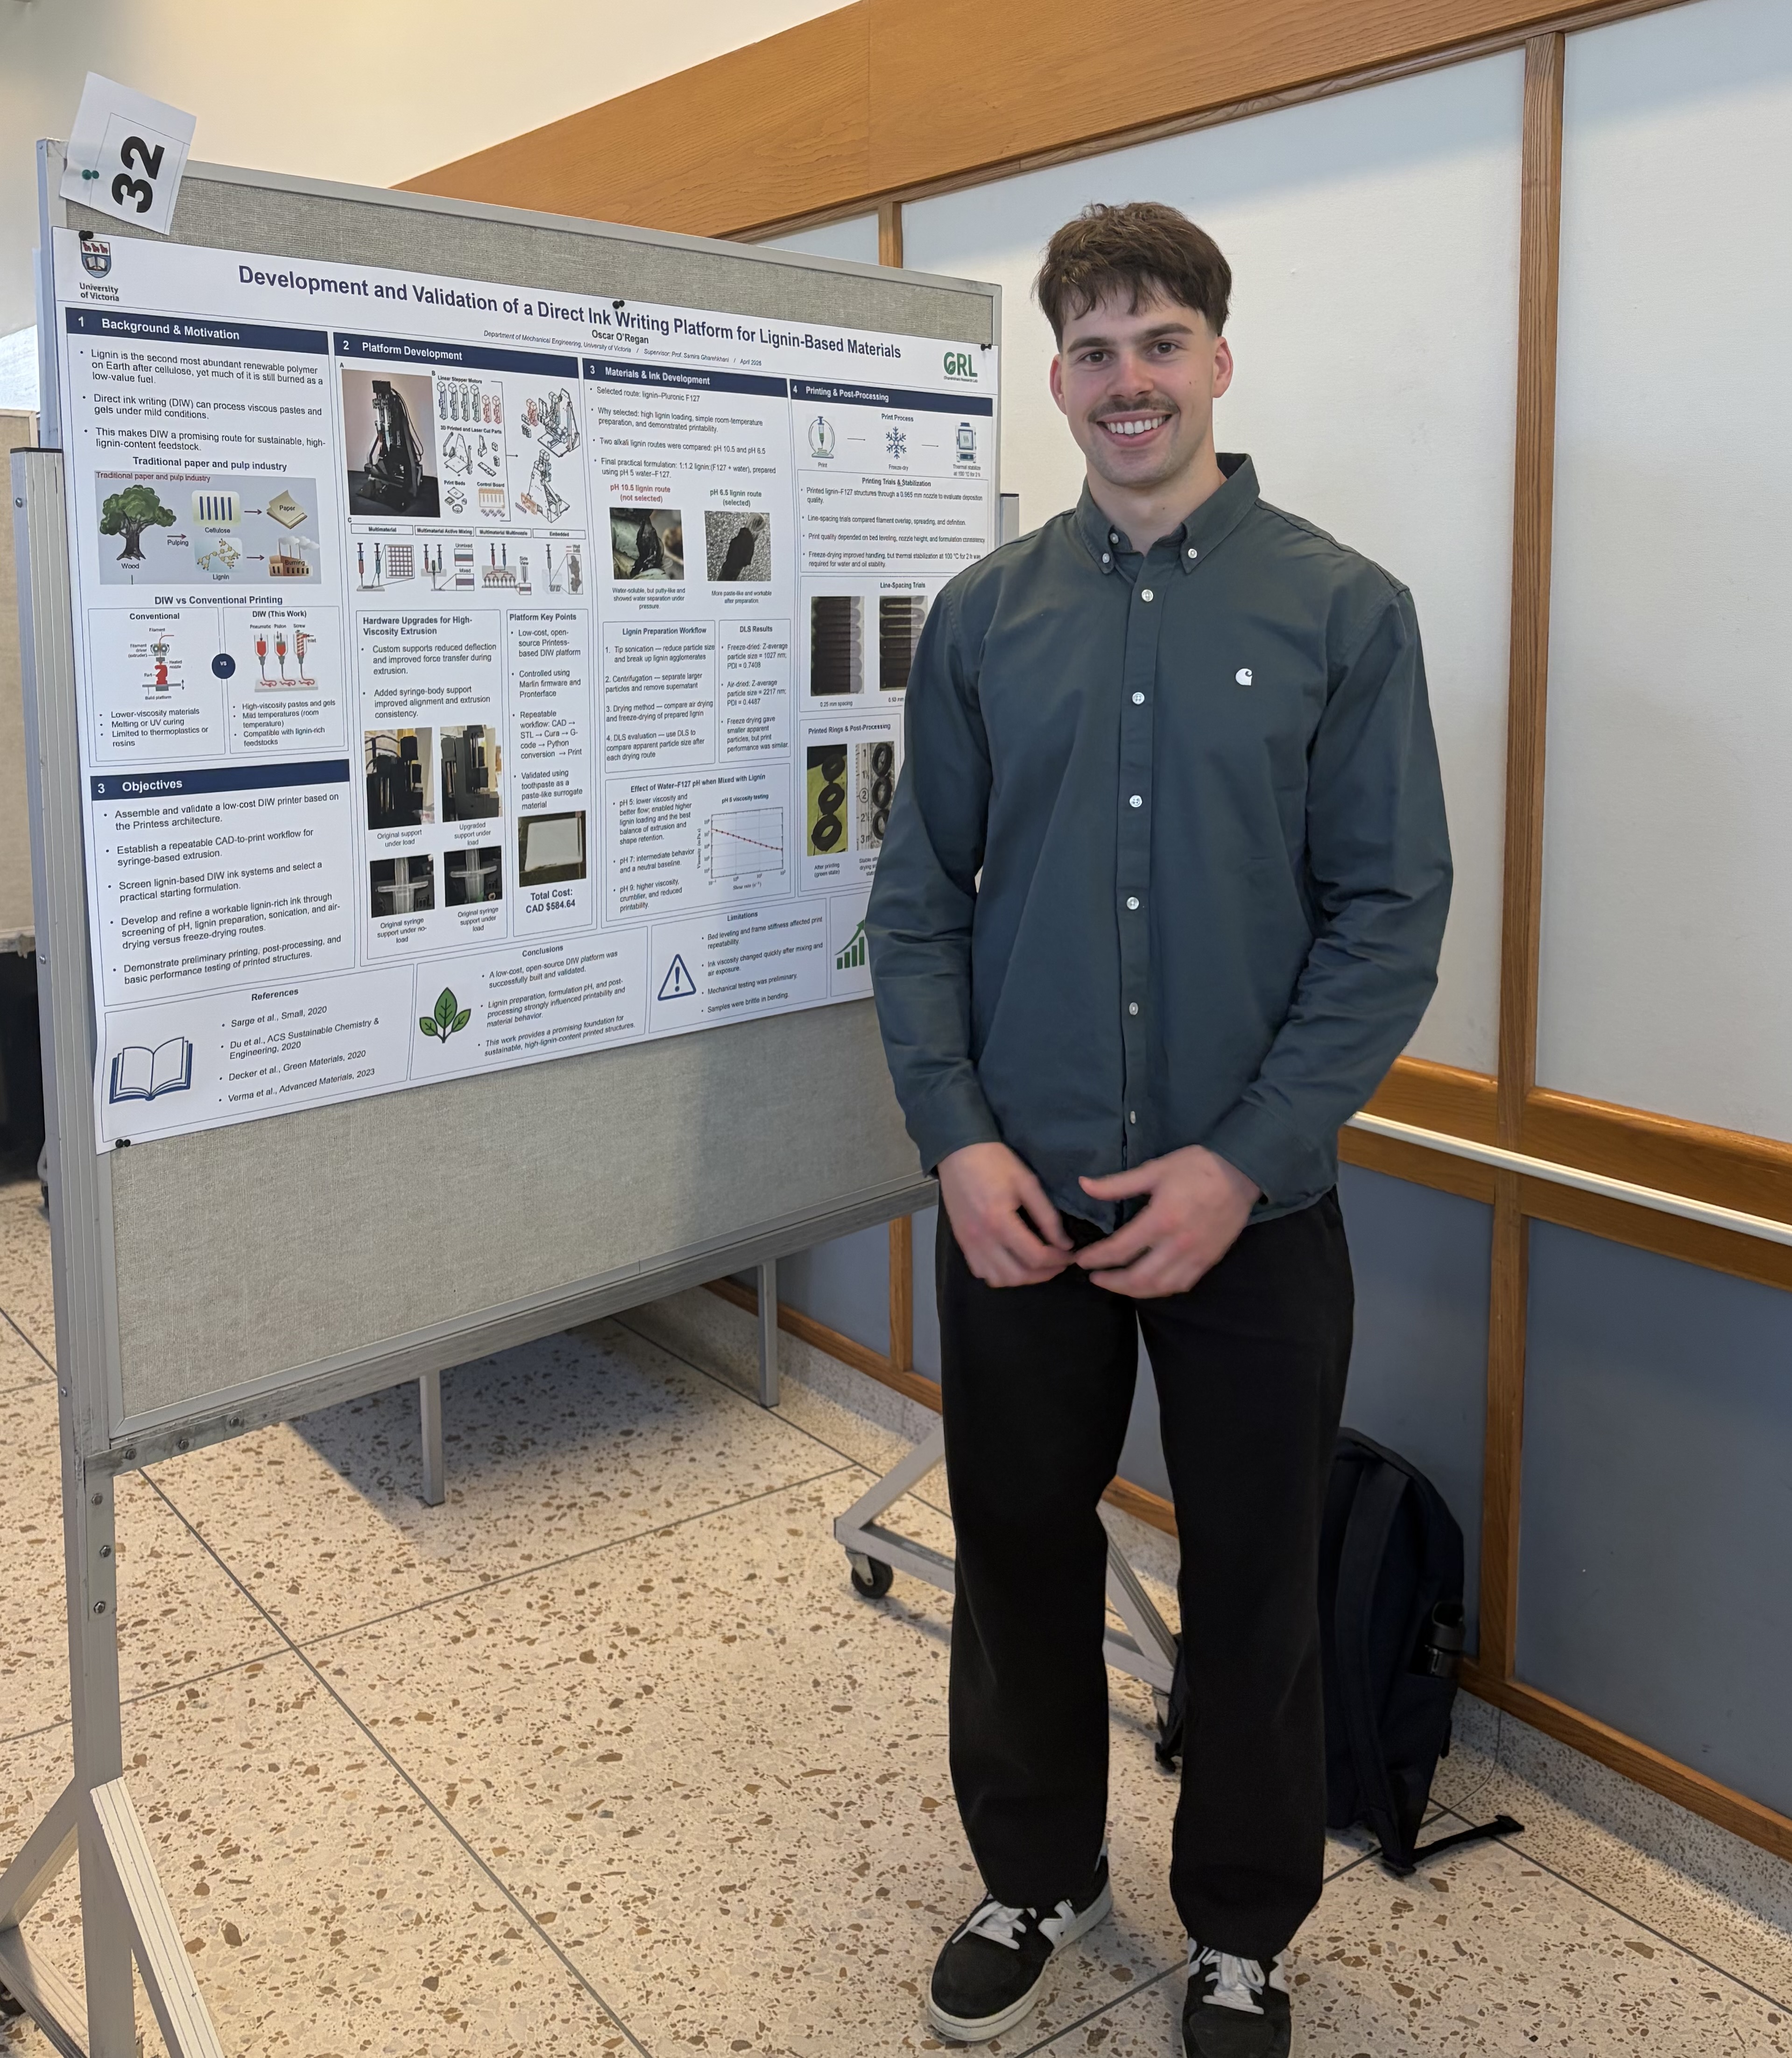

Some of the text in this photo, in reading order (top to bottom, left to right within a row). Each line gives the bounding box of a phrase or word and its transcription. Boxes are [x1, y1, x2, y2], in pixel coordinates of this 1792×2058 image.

[112, 136, 165, 213] 32
[79, 282, 118, 295] University
[90, 292, 119, 302] Victoria
[239, 265, 901, 358] Development and Validation of a Direct Ink Writing Platform for Lignin-Based Materials
[78, 316, 239, 340] 1 Background & Motivation
[484, 330, 515, 339] Department
[522, 334, 550, 343] Mechanical
[551, 338, 582, 348] Engineering,
[583, 341, 607, 351] University
[592, 329, 649, 345] Oscar O'Regan
[343, 340, 462, 360] 2 Platform Development
[91, 349, 118, 359] Lignin
[121, 351, 128, 359] is
[130, 352, 144, 360] the
[147, 355, 177, 363] second
[203, 358, 241, 368] abundant
[243, 362, 284, 371] renewable
[287, 365, 317, 374] polymer
[944, 352, 978, 377] GRL
[92, 371, 155, 383] low-value fuel.
[590, 365, 710, 385] 3 Materials & Ink Development
[597, 386, 622, 395] Selected
[805, 386, 831, 398] Printing
[839, 389, 889, 402] Post-Processing
[94, 405, 113, 415] gels
[116, 407, 141, 415] under
[164, 410, 209, 419] conditions.
[132, 456, 181, 466] Traditional
[184, 460, 210, 469] paper
[231, 461, 250, 471] pulp
[252, 461, 287, 472] industry
[610, 483, 619, 492] pH
[635, 484, 653, 493] lignin
[861, 477, 882, 486] Printing
[620, 493, 663, 503] (not selected)
[723, 499, 750, 507] (selected)
[155, 596, 173, 605] DIW
[189, 596, 247, 604] Conventional
[249, 596, 282, 605] Printing
[402, 616, 437, 626] Upgrades
[452, 616, 472, 625] High-
[540, 613, 553, 622] Key
[363, 627, 398, 637] Viscosity
[622, 628, 642, 636] Lignin
[111, 709, 167, 718] Lower-viscosity
[98, 779, 182, 793] 3 Objectives
[692, 779, 700, 788] pH
[748, 773, 765, 782] Lignin
[133, 820, 169, 829] Printess
[171, 816, 222, 826] architecture.
[530, 888, 572, 901] Total Cost:
[526, 899, 575, 913] CAD $584.64
[727, 912, 758, 921] Limitations
[522, 945, 563, 957] Conclusions
[251, 989, 298, 1001] References
[707, 983, 737, 994] Mechanical
[231, 1018, 255, 1027] Sarge
[281, 1009, 305, 1019] Small,
[308, 1006, 327, 1015] 2020
